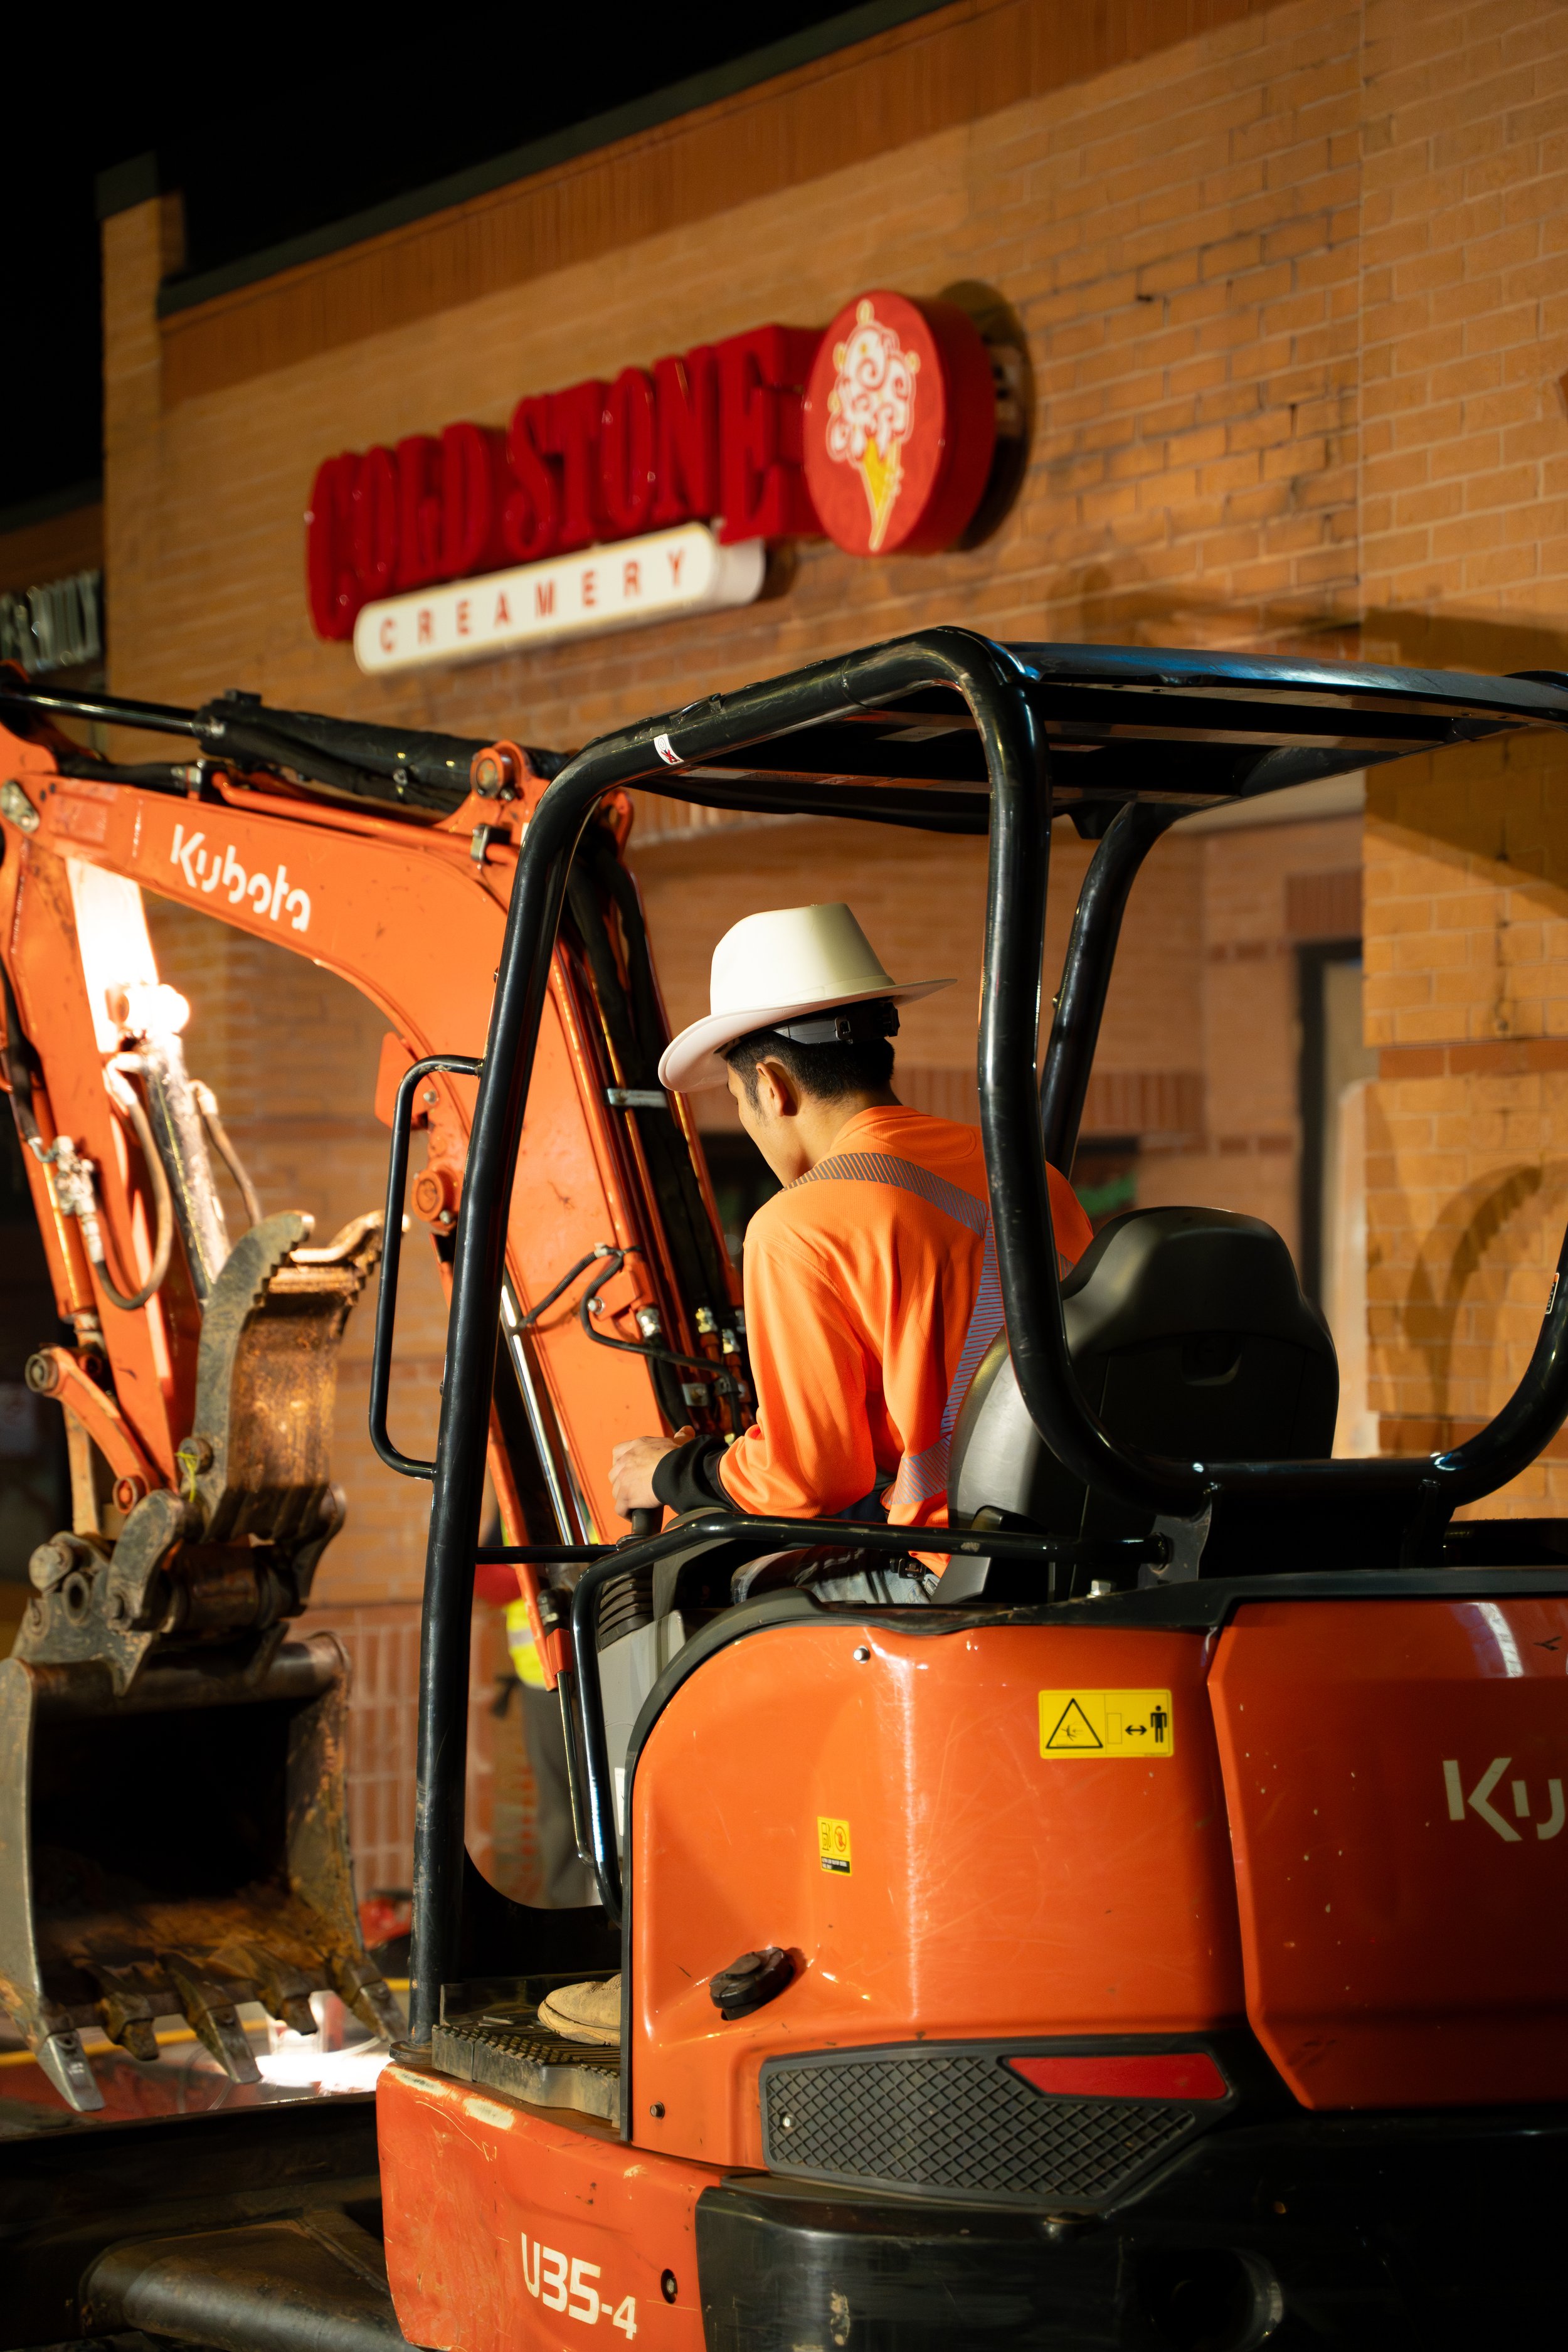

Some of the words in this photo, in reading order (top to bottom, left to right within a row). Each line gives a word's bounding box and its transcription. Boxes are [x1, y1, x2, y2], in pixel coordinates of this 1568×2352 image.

[306, 421, 490, 641] COLD
[504, 324, 783, 559] STONE
[378, 548, 686, 654] CREAMERY
[169, 823, 311, 933] Kubota
[521, 2231, 638, 2341] U35-4
